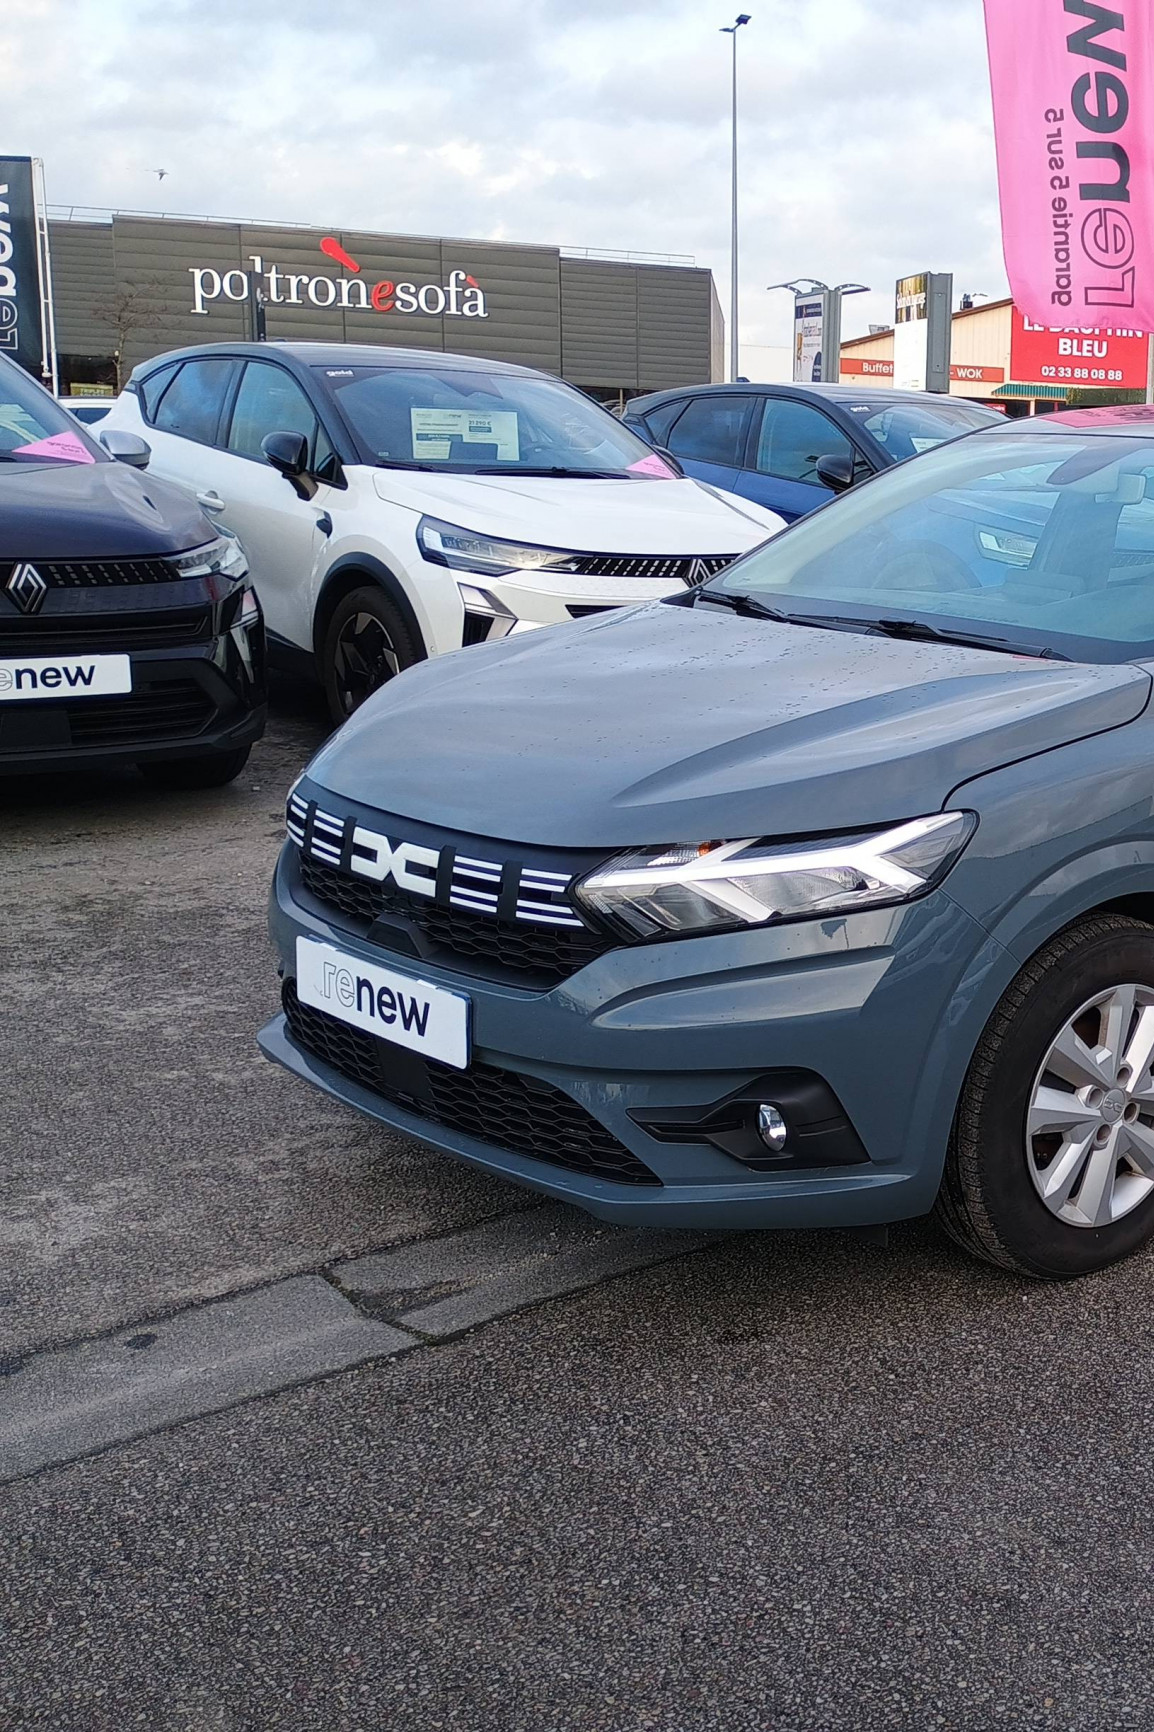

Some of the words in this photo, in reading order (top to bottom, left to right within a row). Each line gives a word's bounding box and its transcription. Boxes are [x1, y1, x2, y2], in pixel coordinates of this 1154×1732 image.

[1058, 338, 1108, 358] BLEU
[862, 362, 894, 374] Buffet
[957, 368, 983, 380] WOK
[1041, 366, 1056, 377] 02
[1058, 367, 1072, 378] 33
[1074, 368, 1089, 379] 88
[1090, 368, 1106, 380] 08
[1107, 370, 1122, 381] 88
[323, 961, 431, 1038] renew
